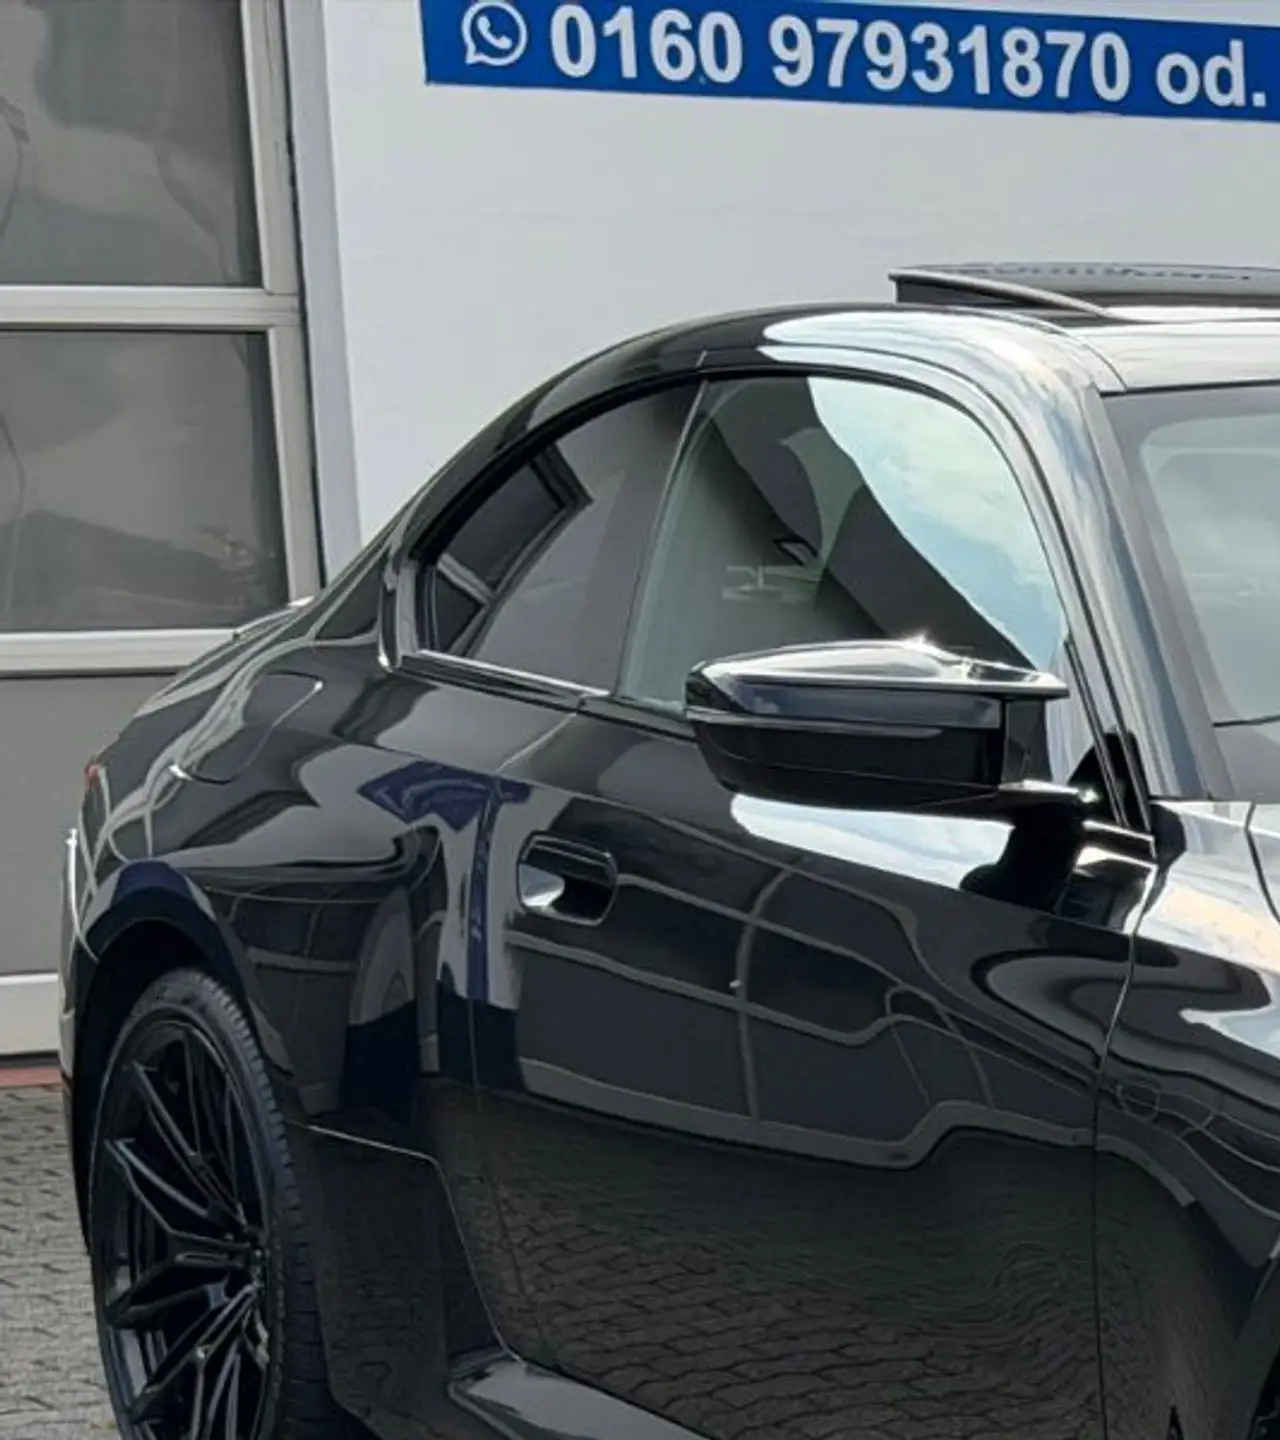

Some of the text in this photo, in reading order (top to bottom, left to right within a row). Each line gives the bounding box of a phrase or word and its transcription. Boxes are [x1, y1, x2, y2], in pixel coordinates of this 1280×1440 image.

[551, 3, 743, 83] 0160
[769, 15, 1130, 101] 97931870
[1156, 40, 1266, 106] od.
